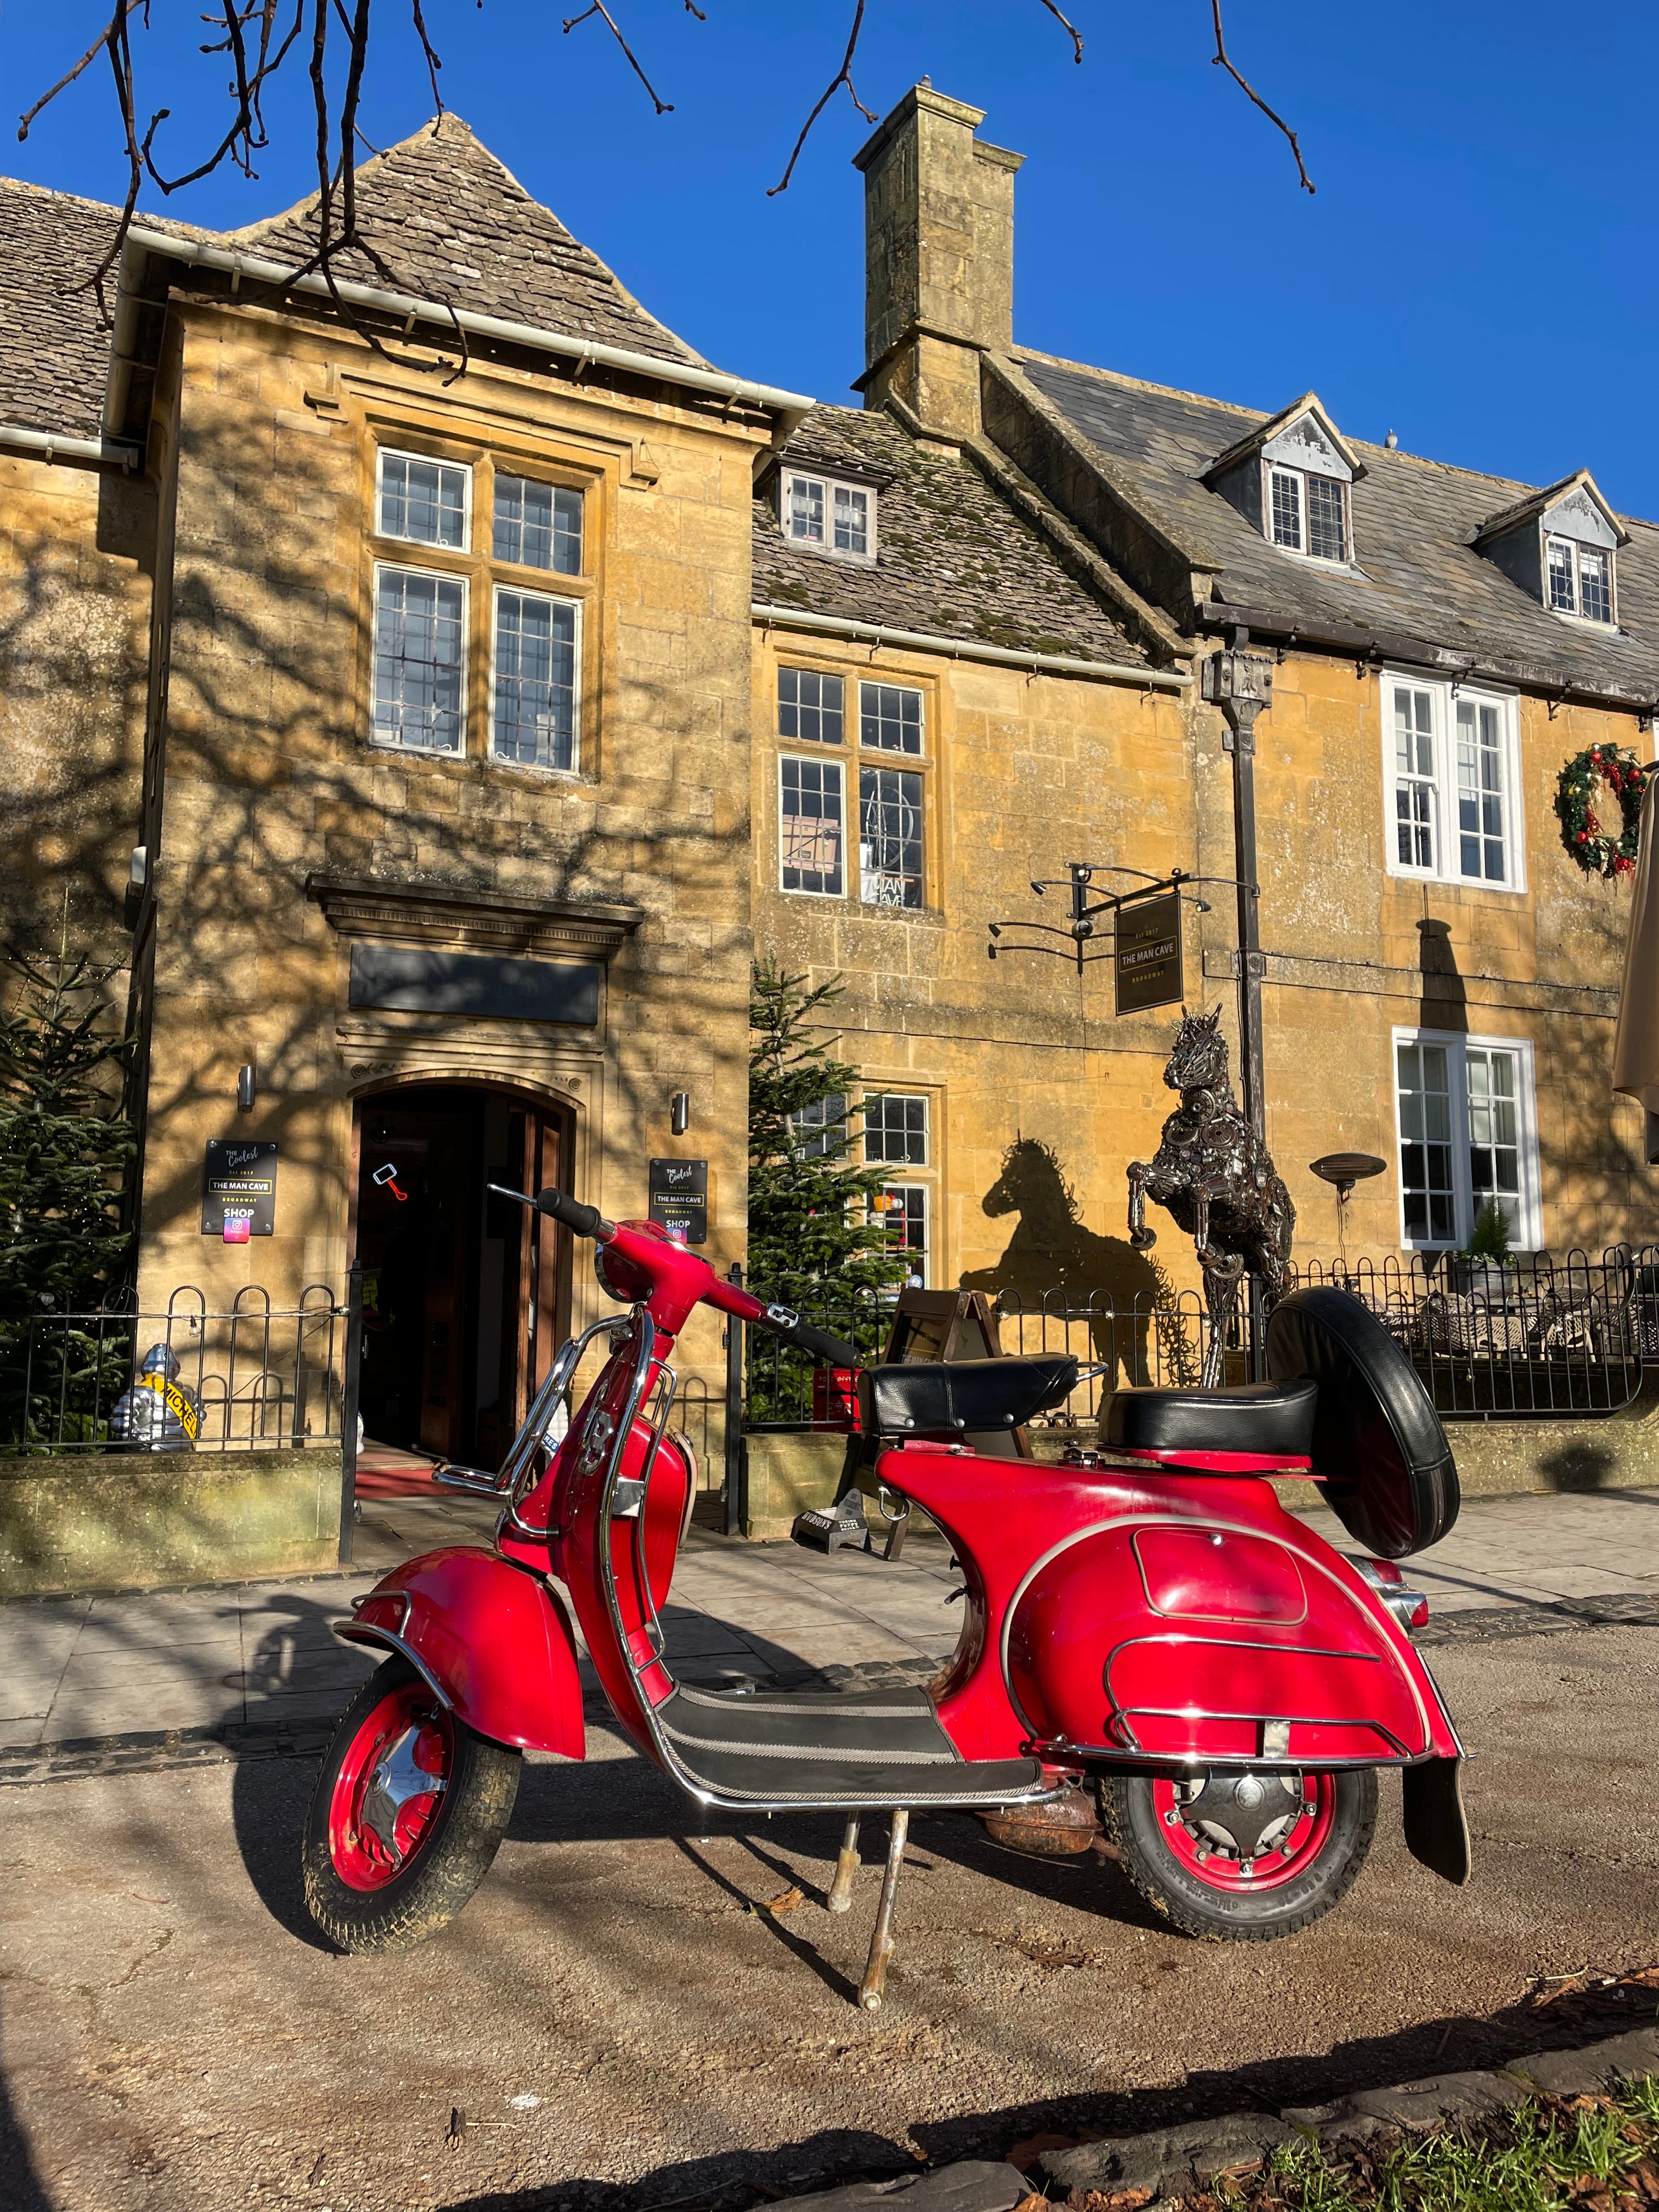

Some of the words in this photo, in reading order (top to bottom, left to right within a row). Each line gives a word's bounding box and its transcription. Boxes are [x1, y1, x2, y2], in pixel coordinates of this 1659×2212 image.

[1146, 928, 1159, 936] 2017
[1122, 953, 1137, 966] THE
[1137, 949, 1154, 962] MAN
[1155, 943, 1174, 957] CAVE
[1132, 970, 1164, 983] BROADWAY
[228, 1146, 258, 1167] Coolest
[669, 1165, 693, 1184] Coolest
[223, 1208, 255, 1218] SHOP
[666, 1220, 691, 1228] SHOP
[544, 1435, 558, 1449] RES
[802, 1511, 832, 1530] HUDSON'S
